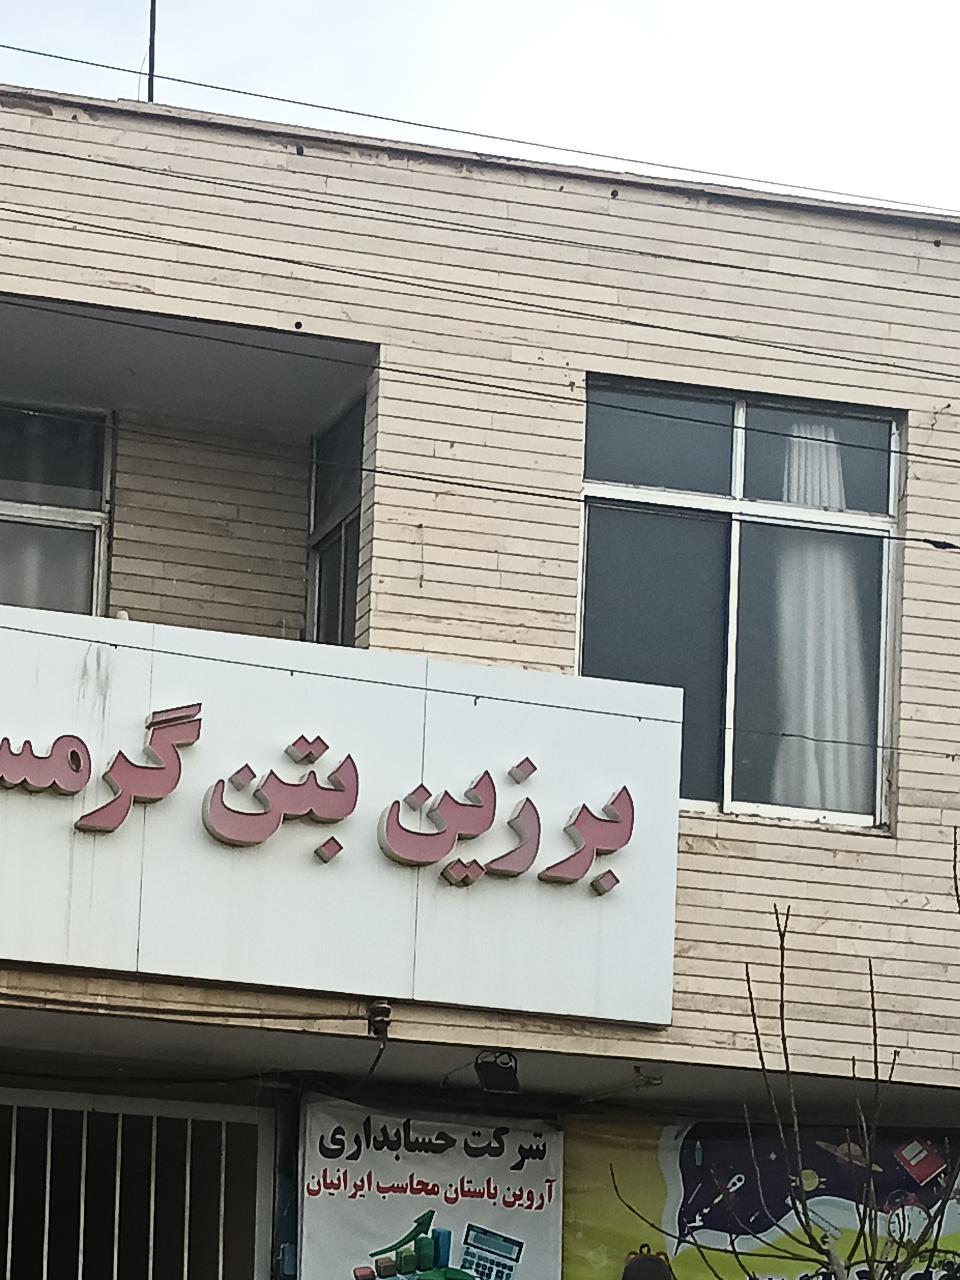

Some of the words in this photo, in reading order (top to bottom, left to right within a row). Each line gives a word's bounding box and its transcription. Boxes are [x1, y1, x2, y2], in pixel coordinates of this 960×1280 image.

[201, 733, 360, 865] بتن
[377, 755, 637, 897] برزین
[318, 1115, 457, 1162] حسابداری
[463, 1126, 548, 1171] شرکت
[306, 1167, 373, 1199] ایرانیان
[376, 1172, 440, 1200] محاسب
[443, 1175, 499, 1206] باستان
[501, 1177, 557, 1210] آروین
